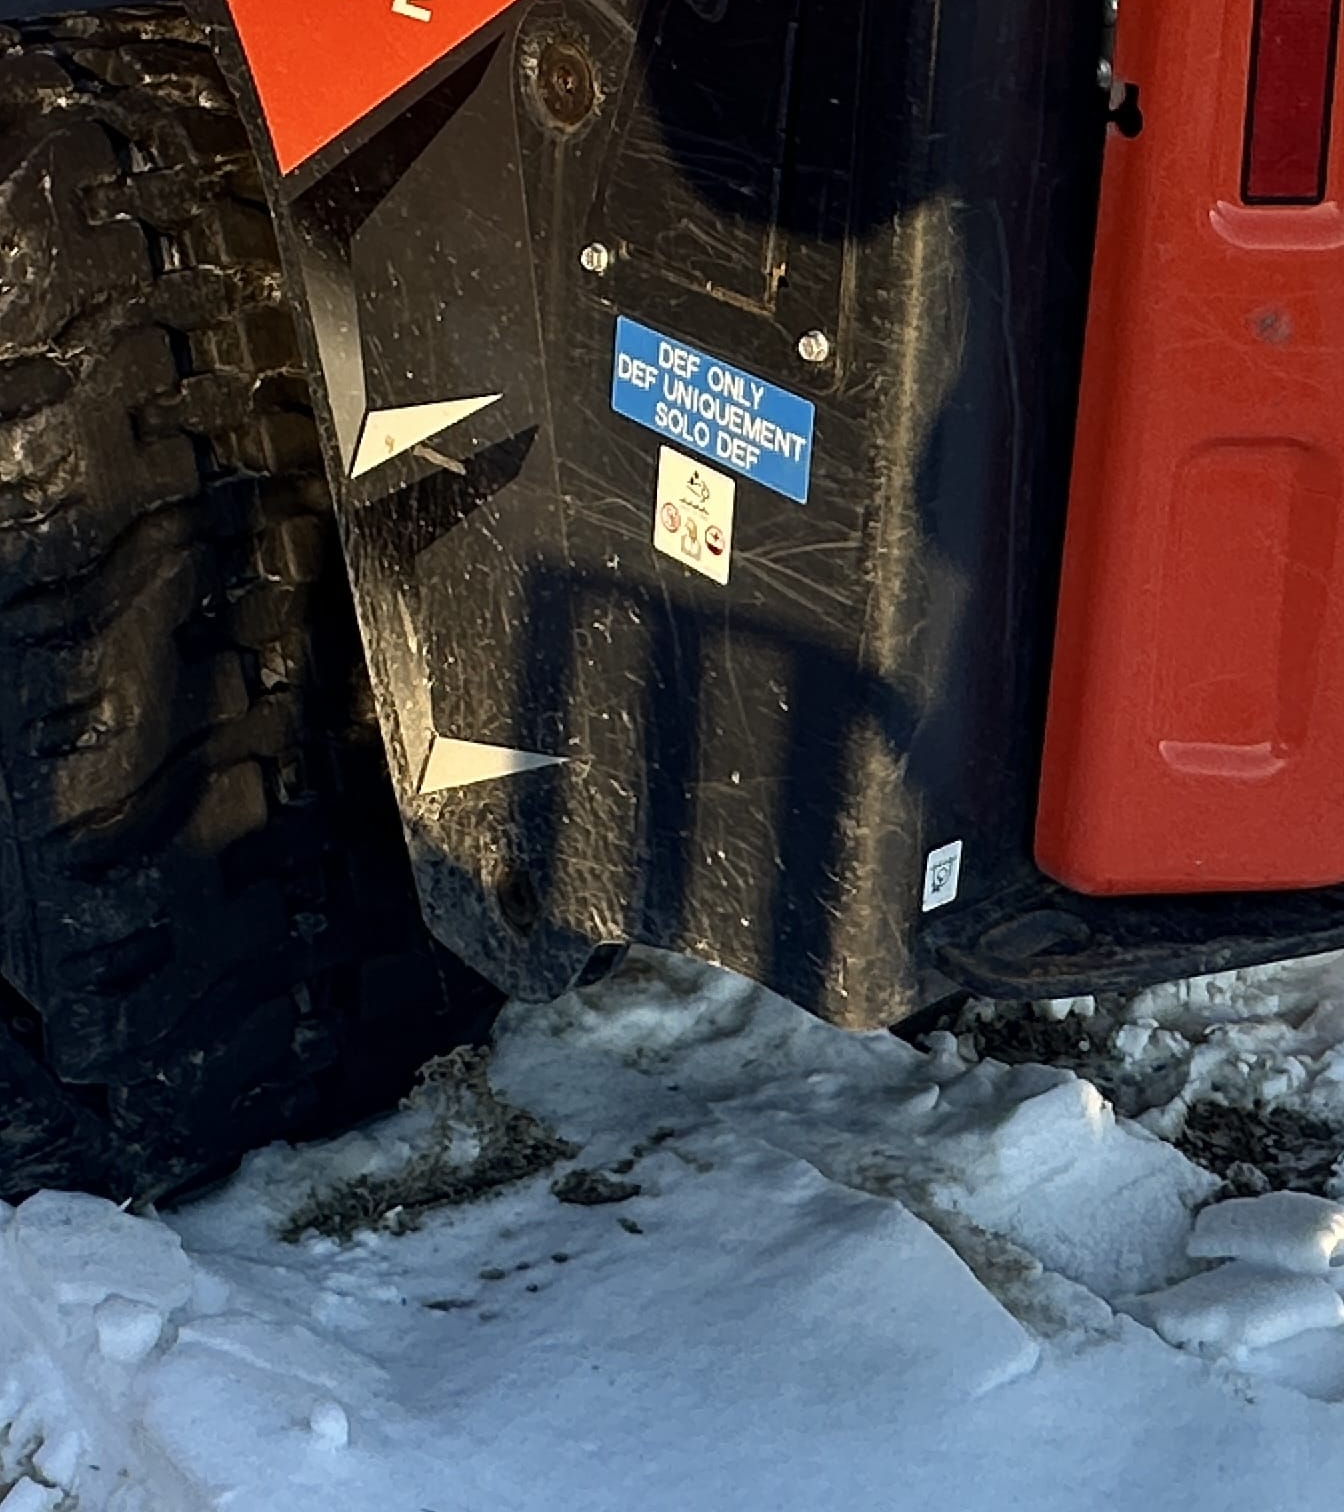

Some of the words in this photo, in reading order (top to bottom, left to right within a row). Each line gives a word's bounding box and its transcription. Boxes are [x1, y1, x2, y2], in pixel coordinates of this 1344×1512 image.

[618, 352, 659, 389] DEF
[663, 374, 807, 462] UNIQUEMENT
[659, 341, 700, 375] DEF
[708, 366, 765, 410] ONLY
[655, 401, 710, 448] SOLO
[716, 430, 761, 470] DEF
